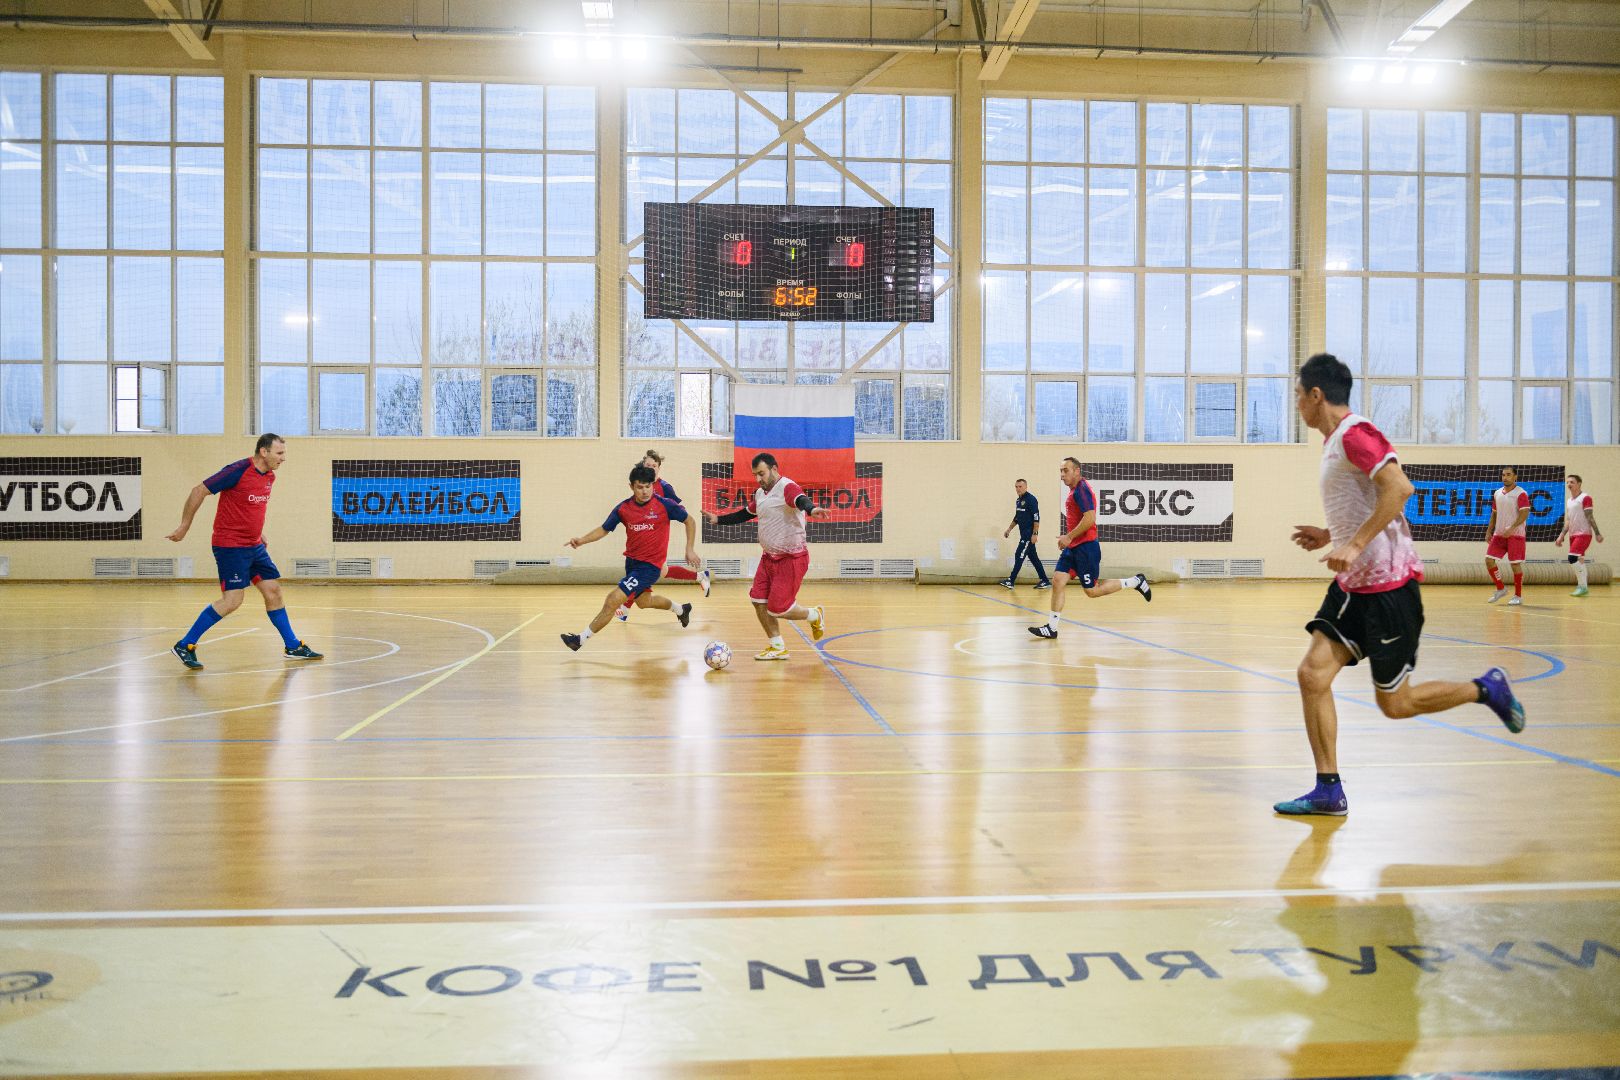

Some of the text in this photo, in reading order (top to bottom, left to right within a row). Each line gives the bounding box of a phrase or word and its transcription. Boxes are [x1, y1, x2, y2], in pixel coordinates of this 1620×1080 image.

[723, 233, 745, 241] СЧЕТ
[773, 238, 807, 247] ПЕРИОД
[776, 279, 804, 287] ВРЕМЯ
[718, 290, 744, 298] ФОЛЫ
[775, 287, 817, 306] 6:52
[836, 291, 862, 299] ФОЛЫ
[342, 485, 511, 515] ВОЛЕЙБОЛ
[715, 488, 871, 509] БАТБОЛ
[1099, 489, 1195, 516] БОКС
[1414, 488, 1553, 517] ТЕННС
[622, 576, 639, 591] 12
[1083, 573, 1091, 585] 5
[334, 961, 702, 999] КОФЕ
[747, 956, 928, 990] №1
[968, 950, 1223, 991] ДЛЯ
